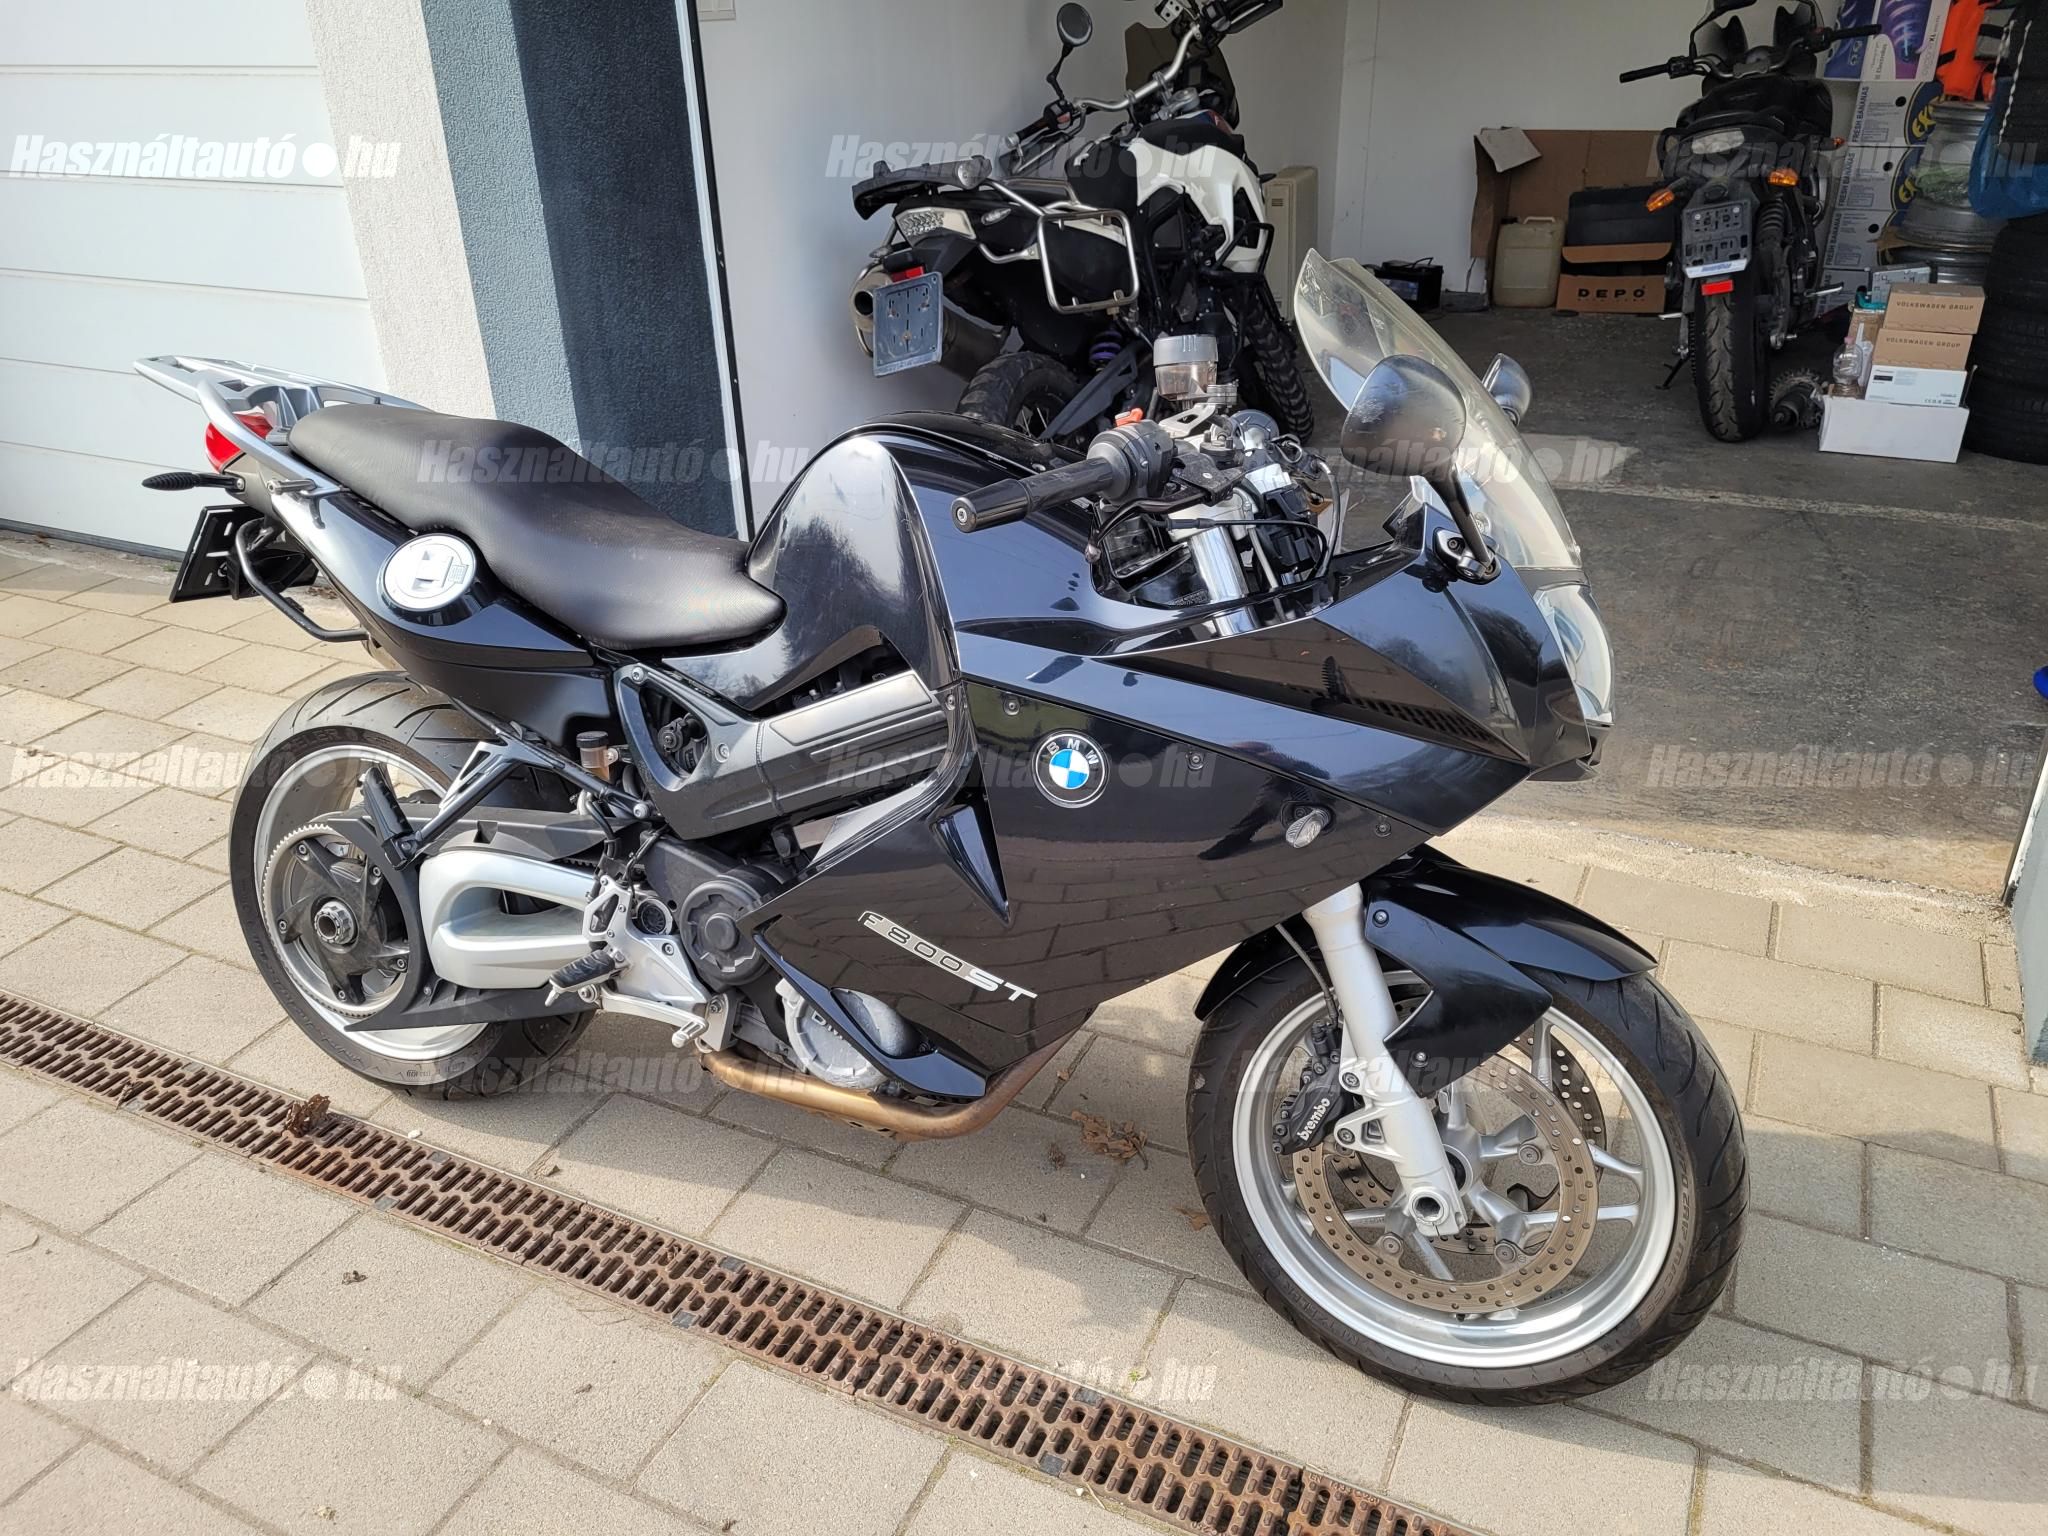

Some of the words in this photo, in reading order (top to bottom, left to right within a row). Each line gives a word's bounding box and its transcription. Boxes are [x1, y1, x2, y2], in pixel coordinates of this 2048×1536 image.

[1857, 86, 1870, 119] BANANAS
[1896, 301, 1946, 310] VOLKSWAGEN
[1046, 738, 1099, 765] BMW
[1297, 1098, 1330, 1141] brembo
